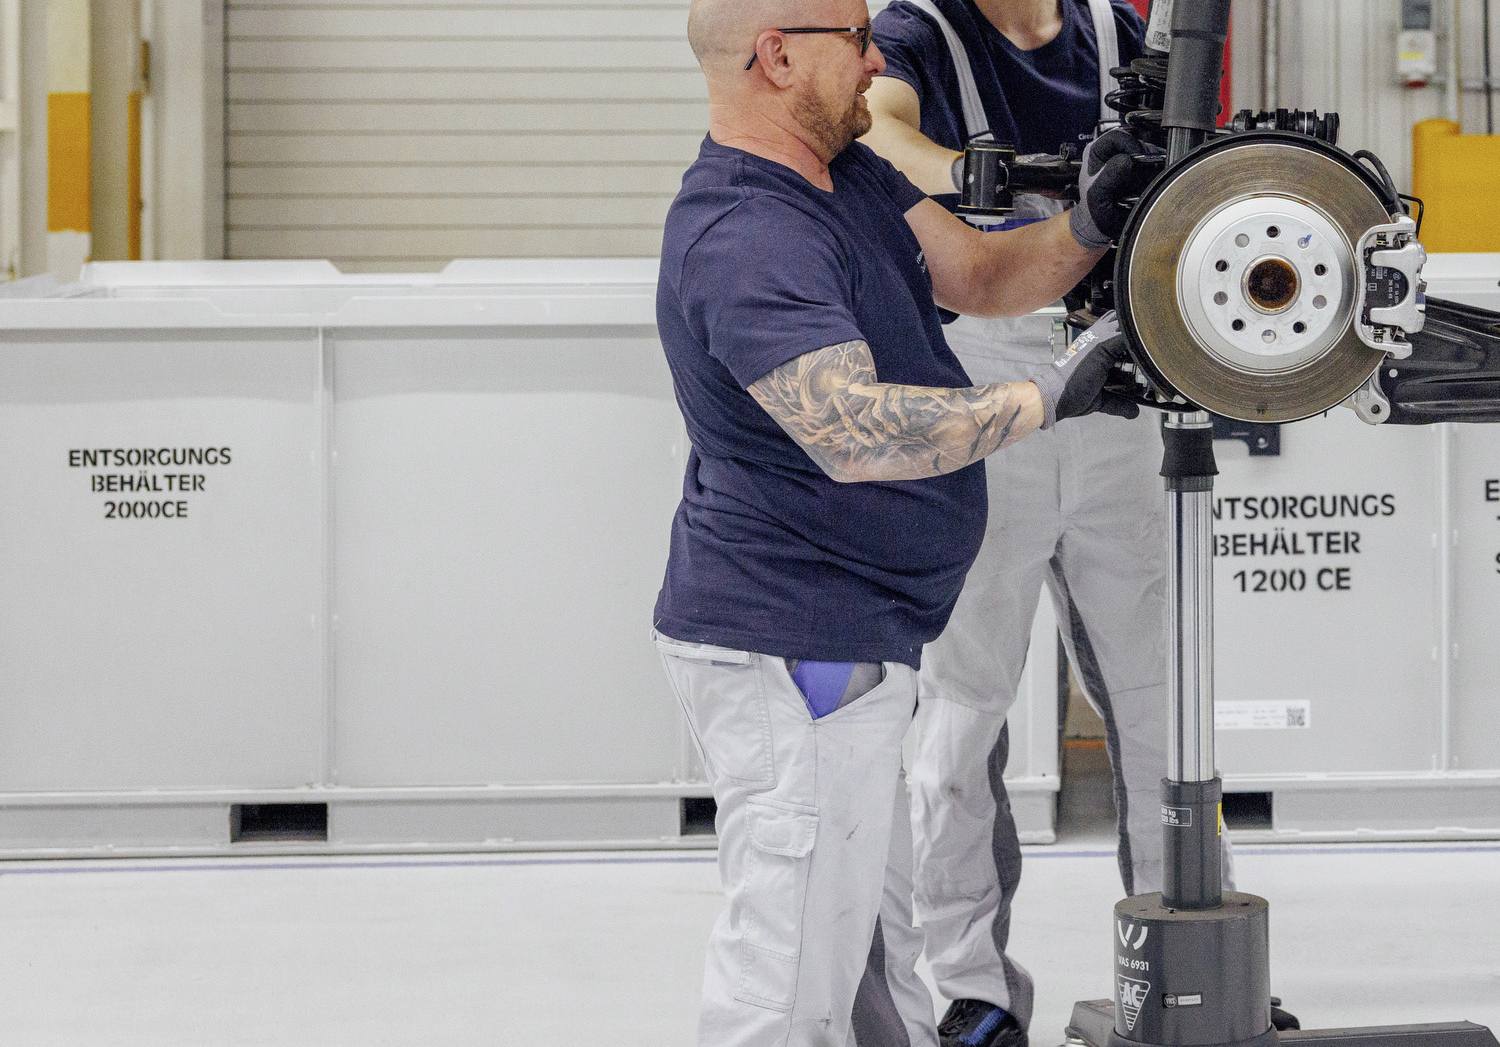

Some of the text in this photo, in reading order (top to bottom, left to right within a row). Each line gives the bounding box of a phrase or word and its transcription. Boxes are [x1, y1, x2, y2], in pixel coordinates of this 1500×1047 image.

[69, 447, 232, 467] ENTSORGUNGS
[92, 470, 206, 492] BEHÄLTER
[104, 501, 188, 518] 2000CE
[1213, 494, 1396, 520] NTSORGUNGS
[1213, 528, 1361, 557] BEHÄLTER
[1233, 567, 1351, 592] 1200 CE
[1118, 955, 1150, 972] VAS 6931
